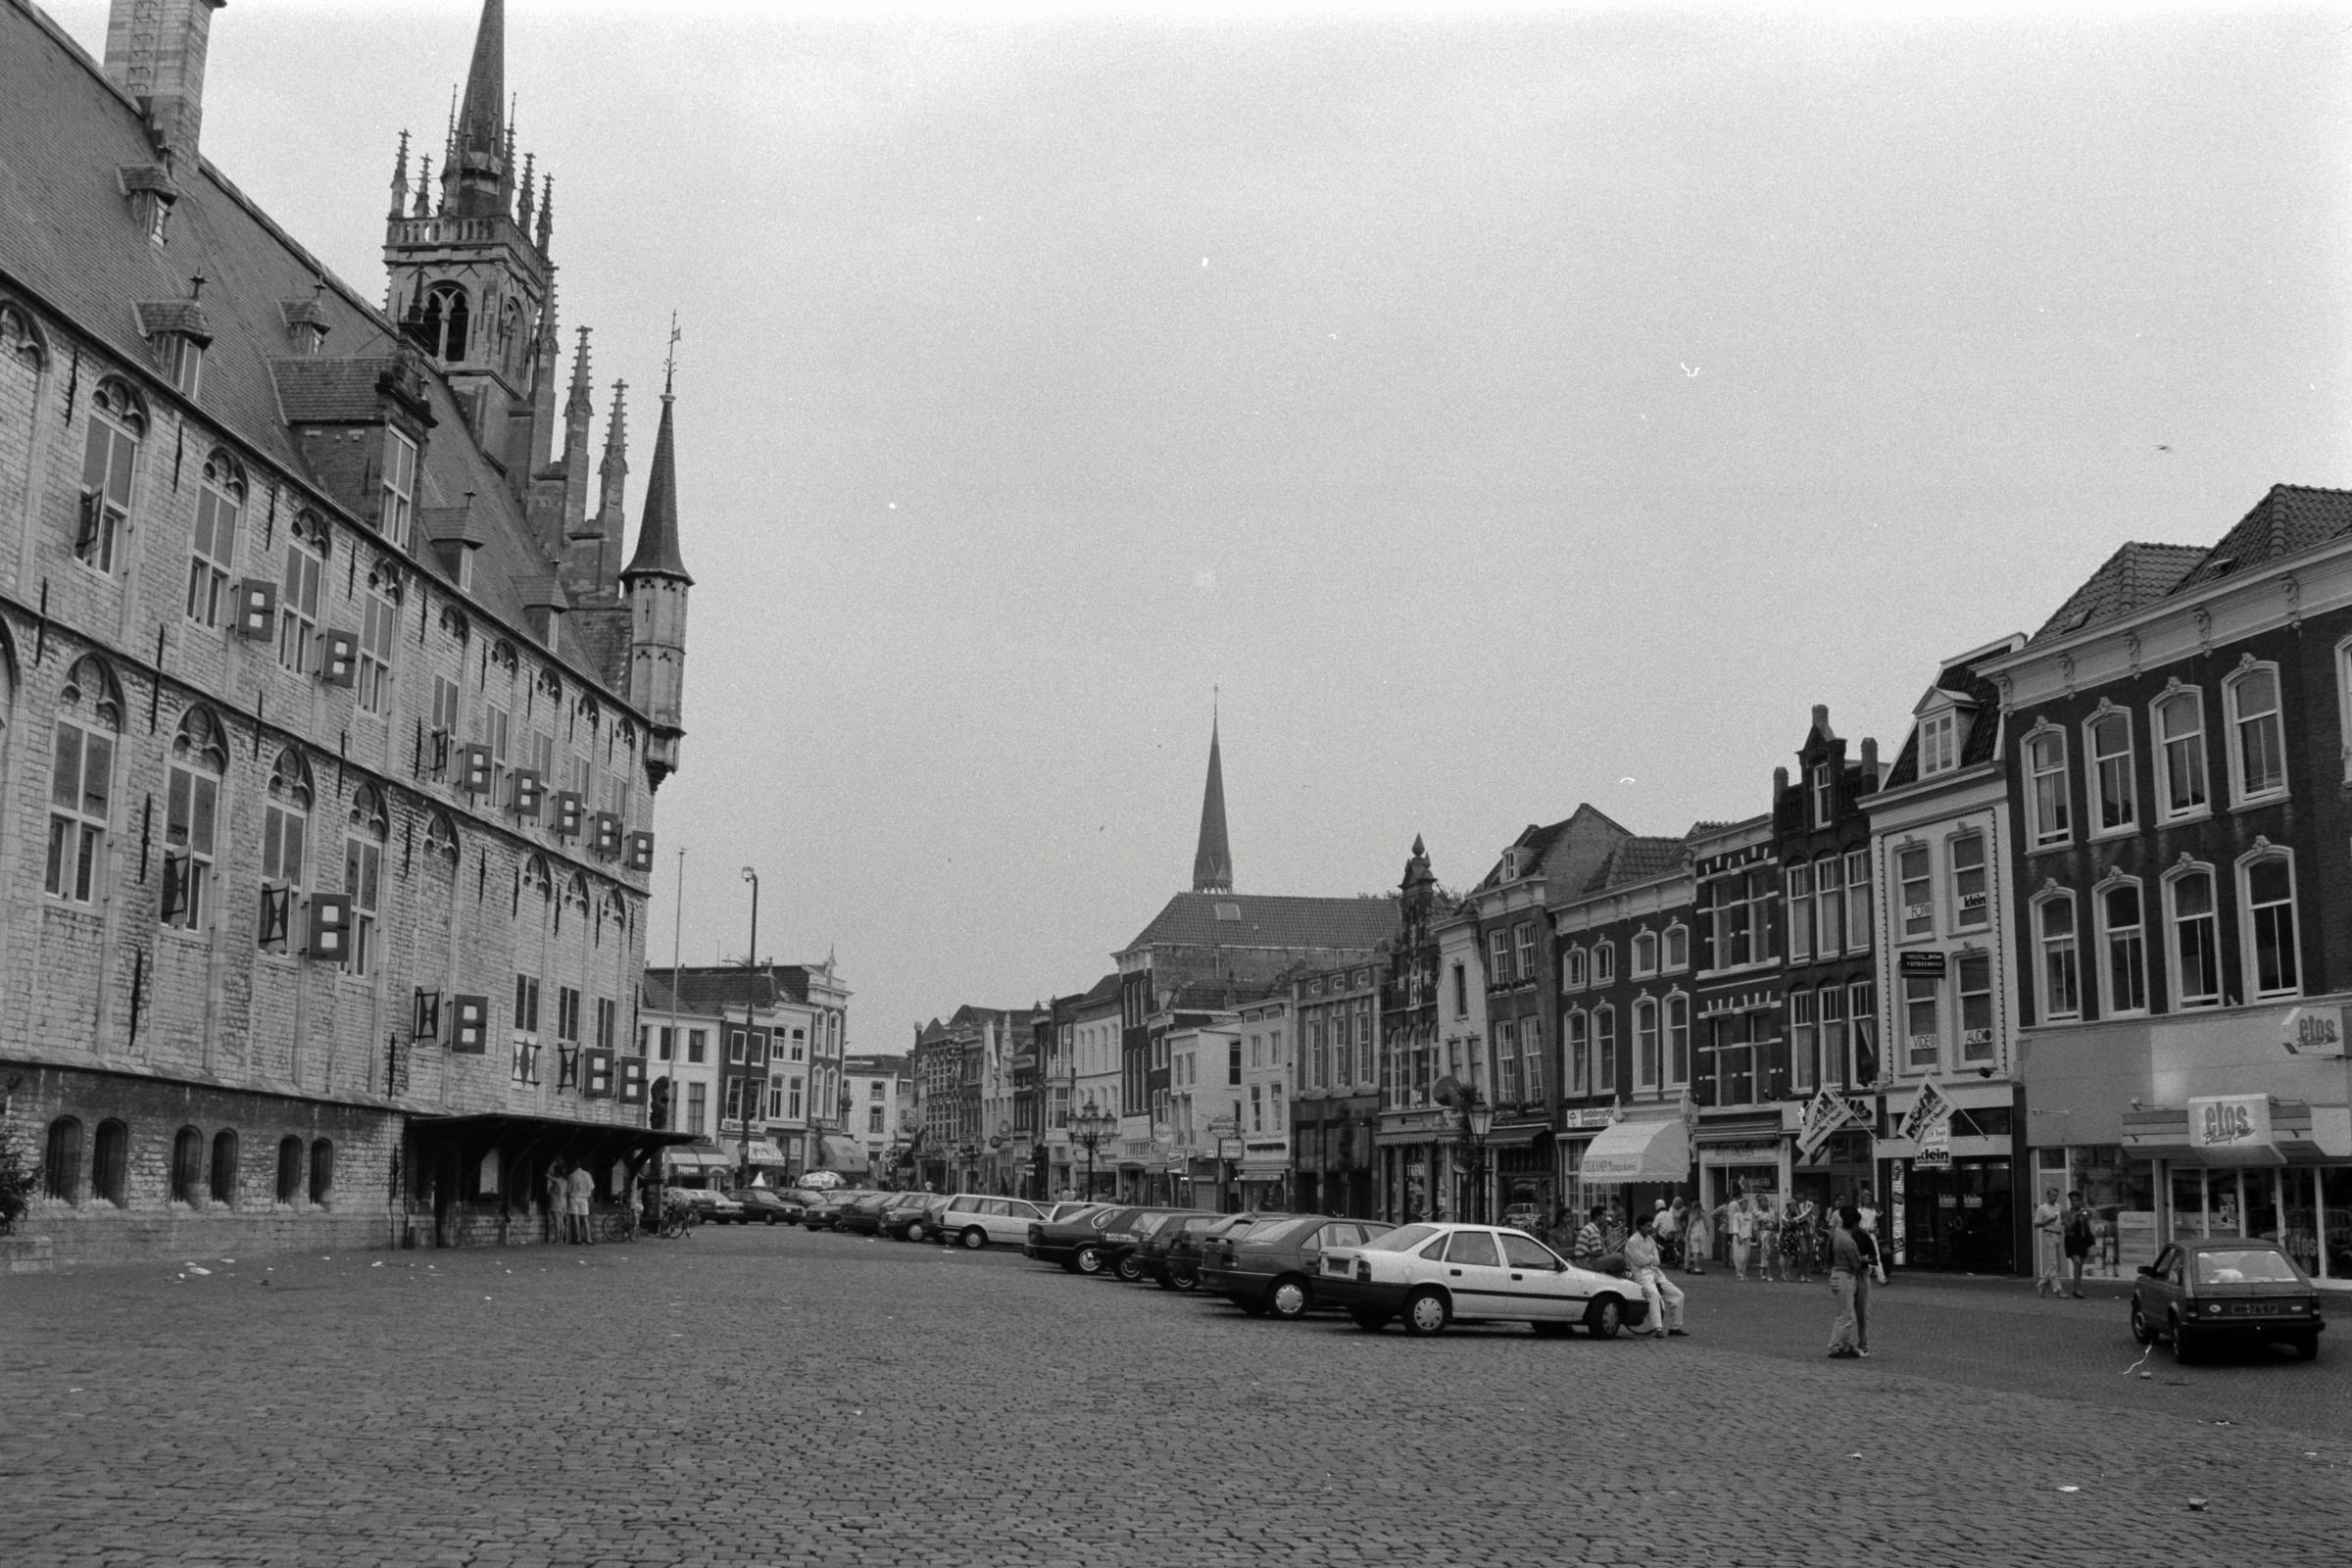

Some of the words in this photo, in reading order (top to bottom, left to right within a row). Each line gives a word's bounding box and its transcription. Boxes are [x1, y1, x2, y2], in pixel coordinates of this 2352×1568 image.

[1964, 894, 1986, 907] klein
[2299, 1015, 2335, 1039] etos
[1913, 1035, 1936, 1048] VIDEO
[1966, 1029, 1991, 1044] AUDIO
[2205, 1102, 2248, 1135] etos
[1917, 1149, 1949, 1159] klein
[1938, 1193, 1957, 1203] klein
[1963, 1193, 1983, 1203] klein
[2289, 1235, 2317, 1256] etos
